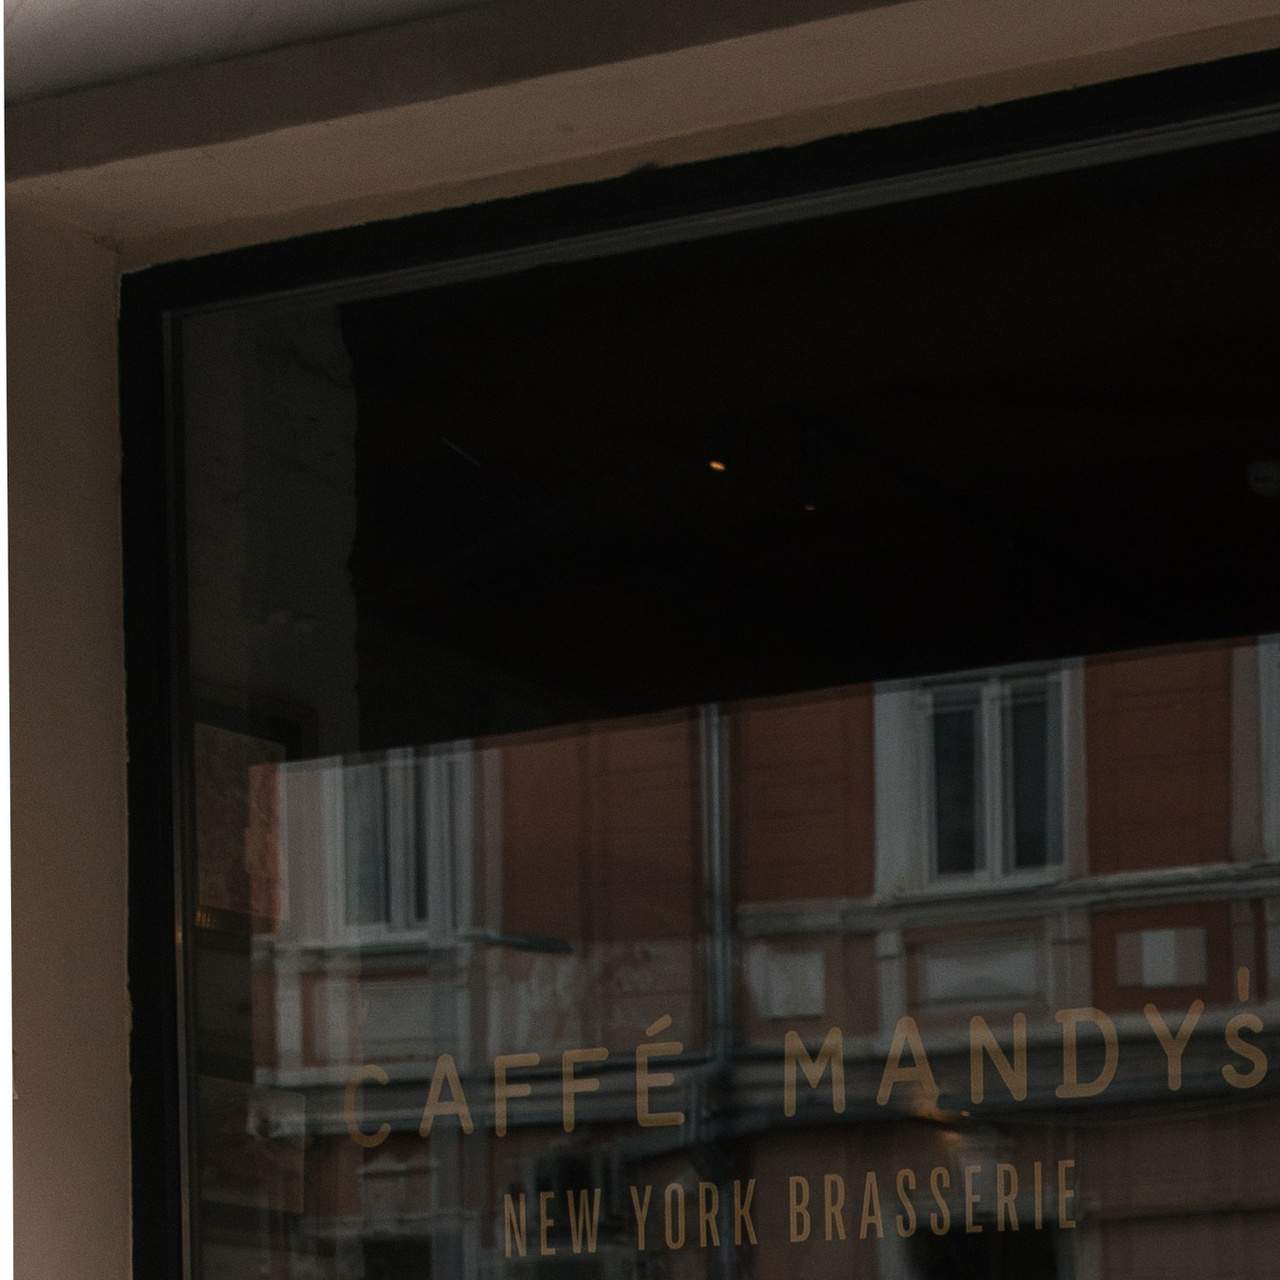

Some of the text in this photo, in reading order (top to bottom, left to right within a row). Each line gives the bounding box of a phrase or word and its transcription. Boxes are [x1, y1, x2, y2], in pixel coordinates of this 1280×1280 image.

[342, 1014, 685, 1148] CAFFÉ
[503, 1159, 1077, 1258] NEW YORK BRASSERIE
